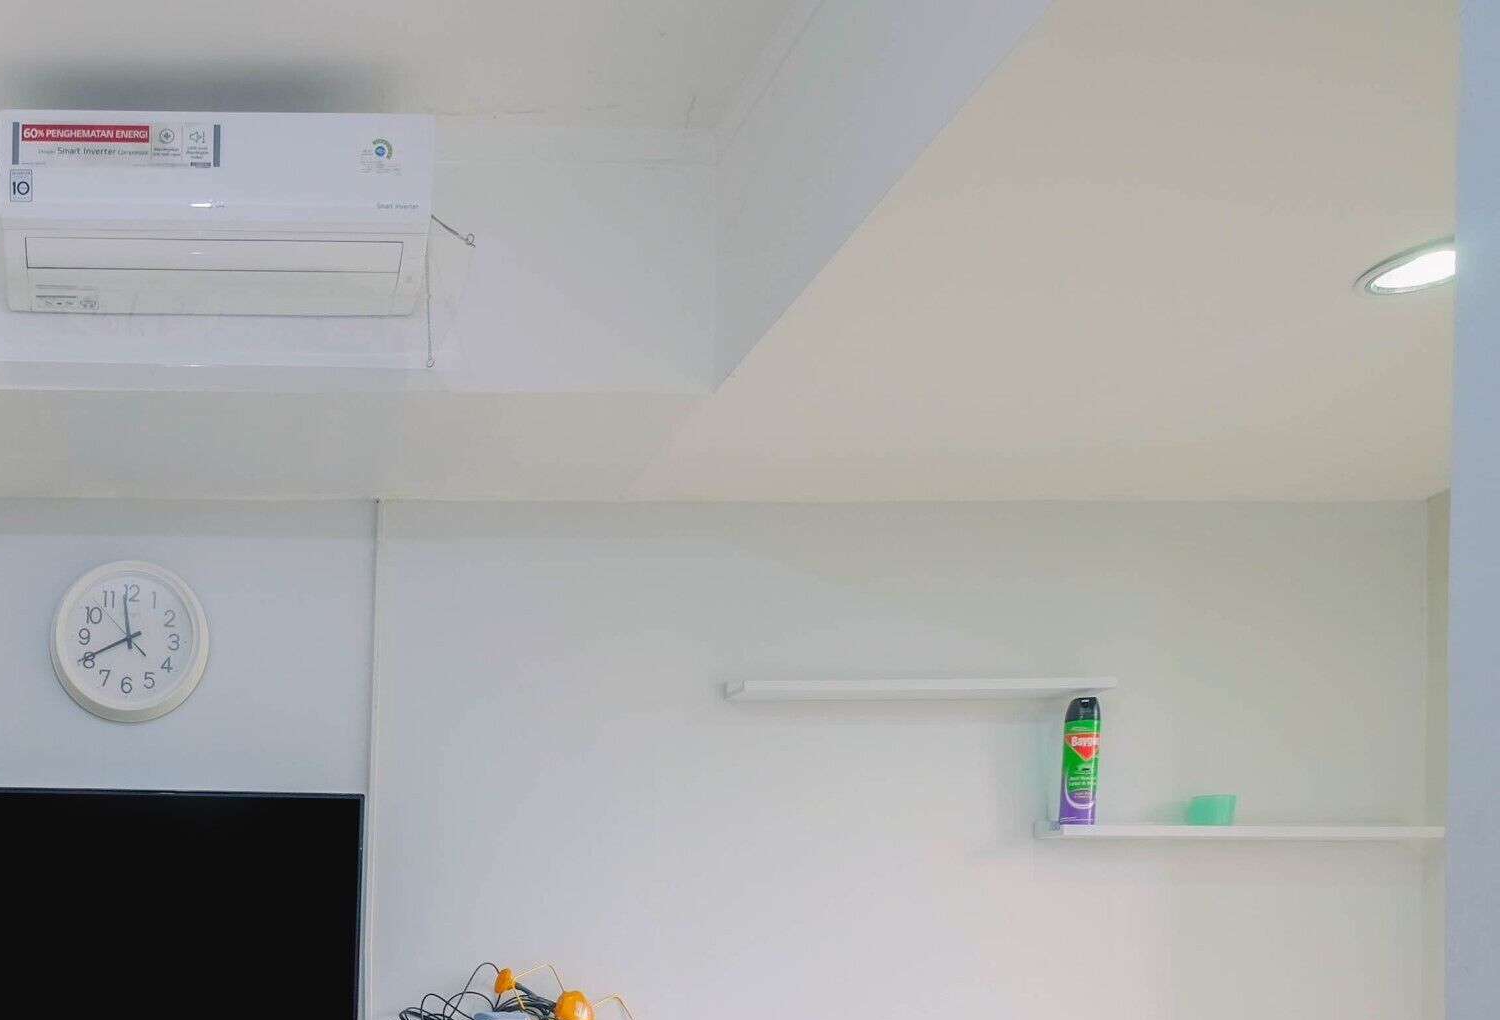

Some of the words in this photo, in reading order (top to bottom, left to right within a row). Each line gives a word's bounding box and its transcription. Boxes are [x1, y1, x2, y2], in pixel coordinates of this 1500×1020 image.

[23, 128, 44, 139] 60%
[46, 129, 114, 139] PENGHEMATAN
[116, 130, 149, 139] ENERGI
[57, 146, 81, 155] Smart
[83, 147, 116, 155] Inverter
[12, 181, 30, 195] 10
[103, 590, 115, 608] 11
[124, 584, 140, 602] 12
[152, 592, 157, 608] 1
[85, 606, 102, 624] 10
[164, 610, 176, 627] 2
[79, 628, 90, 645] 9
[168, 634, 180, 651] 3
[82, 651, 95, 669] 8
[160, 656, 173, 673] 4
[99, 669, 111, 687] 7
[121, 677, 133, 694] 6
[143, 672, 155, 689] 5
[1071, 736, 1100, 747] Bayg
